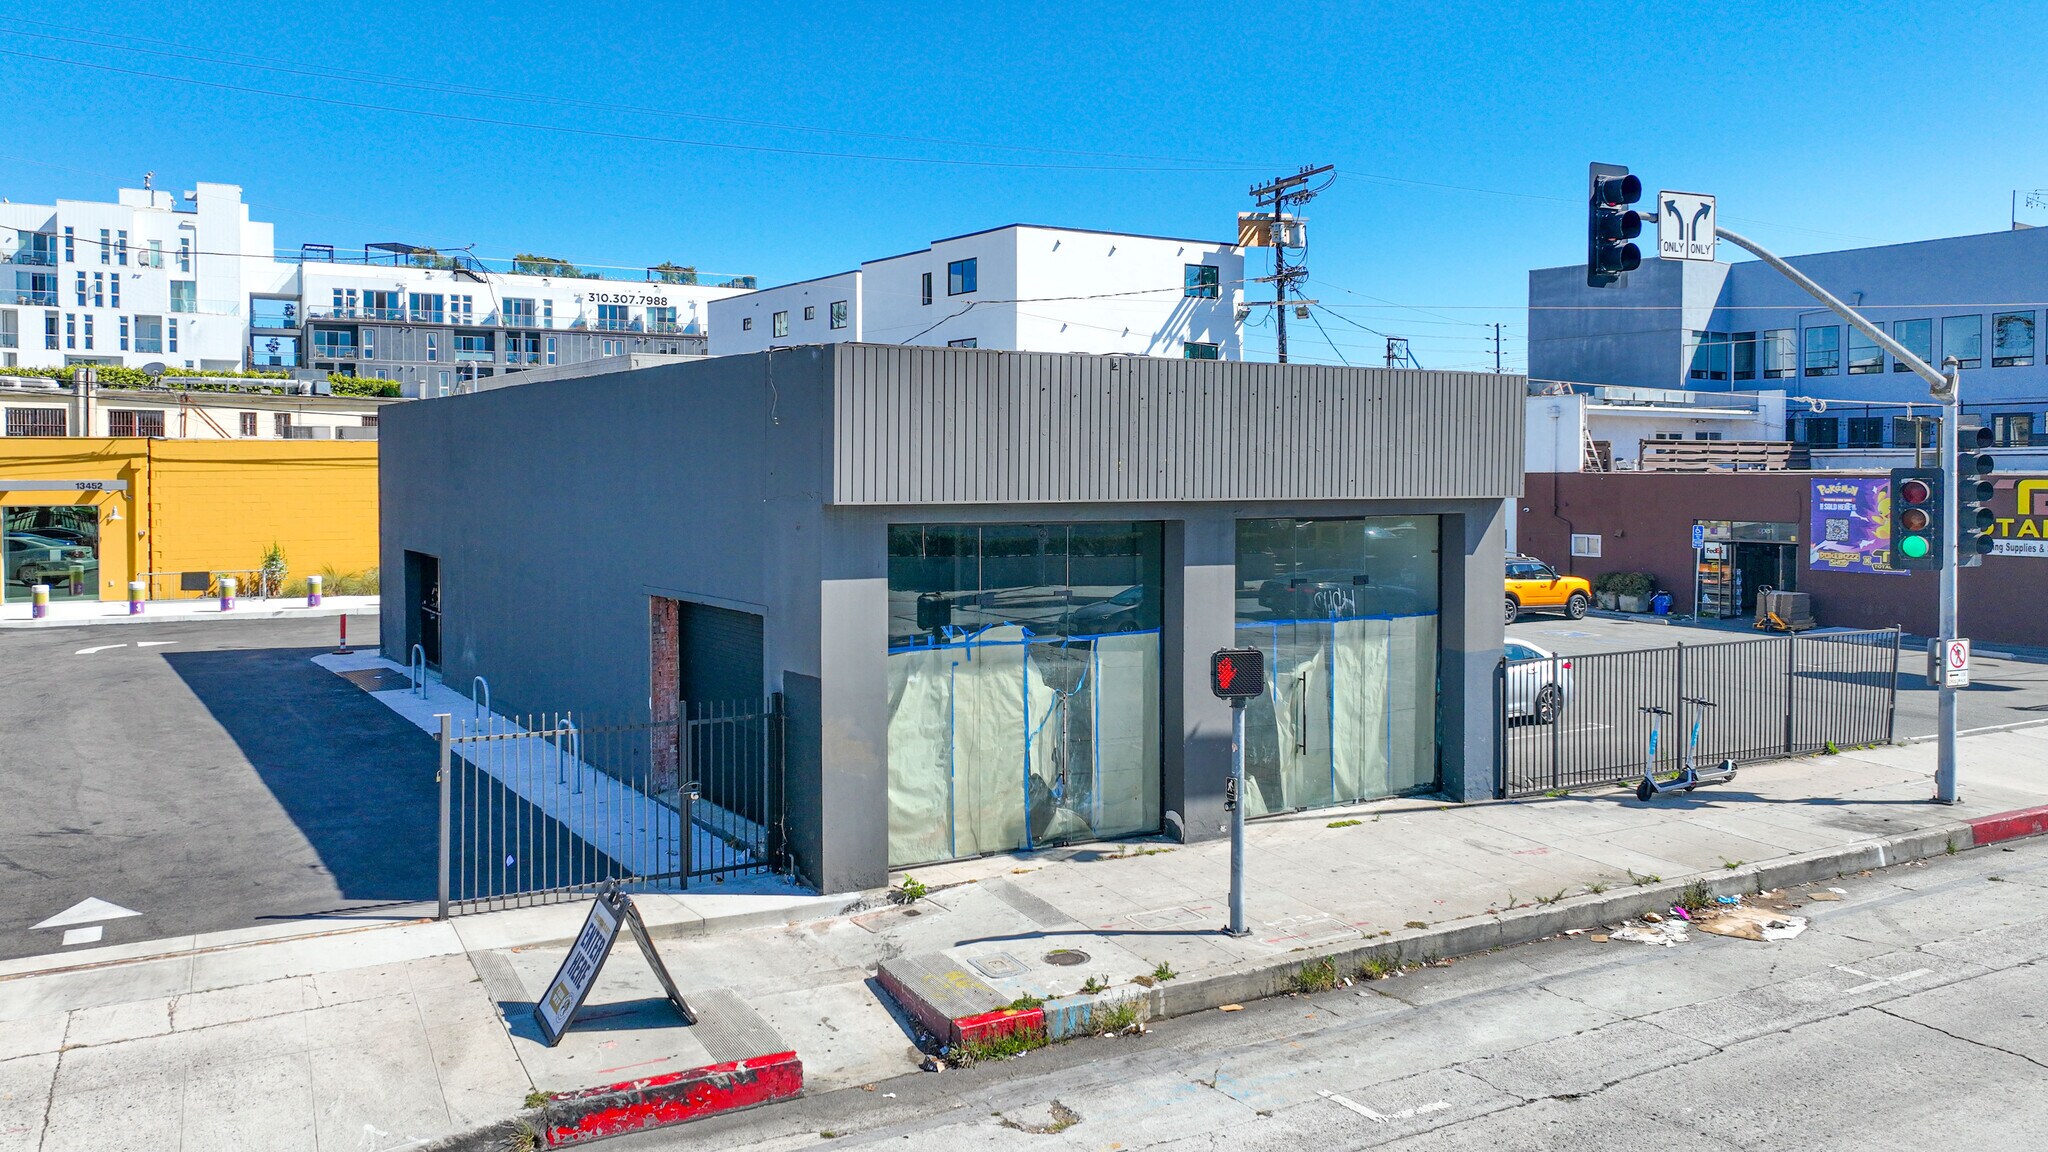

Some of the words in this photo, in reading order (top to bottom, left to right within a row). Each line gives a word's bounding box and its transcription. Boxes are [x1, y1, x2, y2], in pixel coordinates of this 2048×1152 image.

[1663, 241, 1684, 252] ONLY
[1690, 243, 1711, 254] ONLY
[588, 292, 668, 306] 310.307.7988
[75, 482, 103, 490] 13452
[2005, 542, 2037, 554] Supplies
[2039, 543, 2045, 553] &
[580, 922, 606, 964] ENTER
[566, 951, 592, 990] HERE
